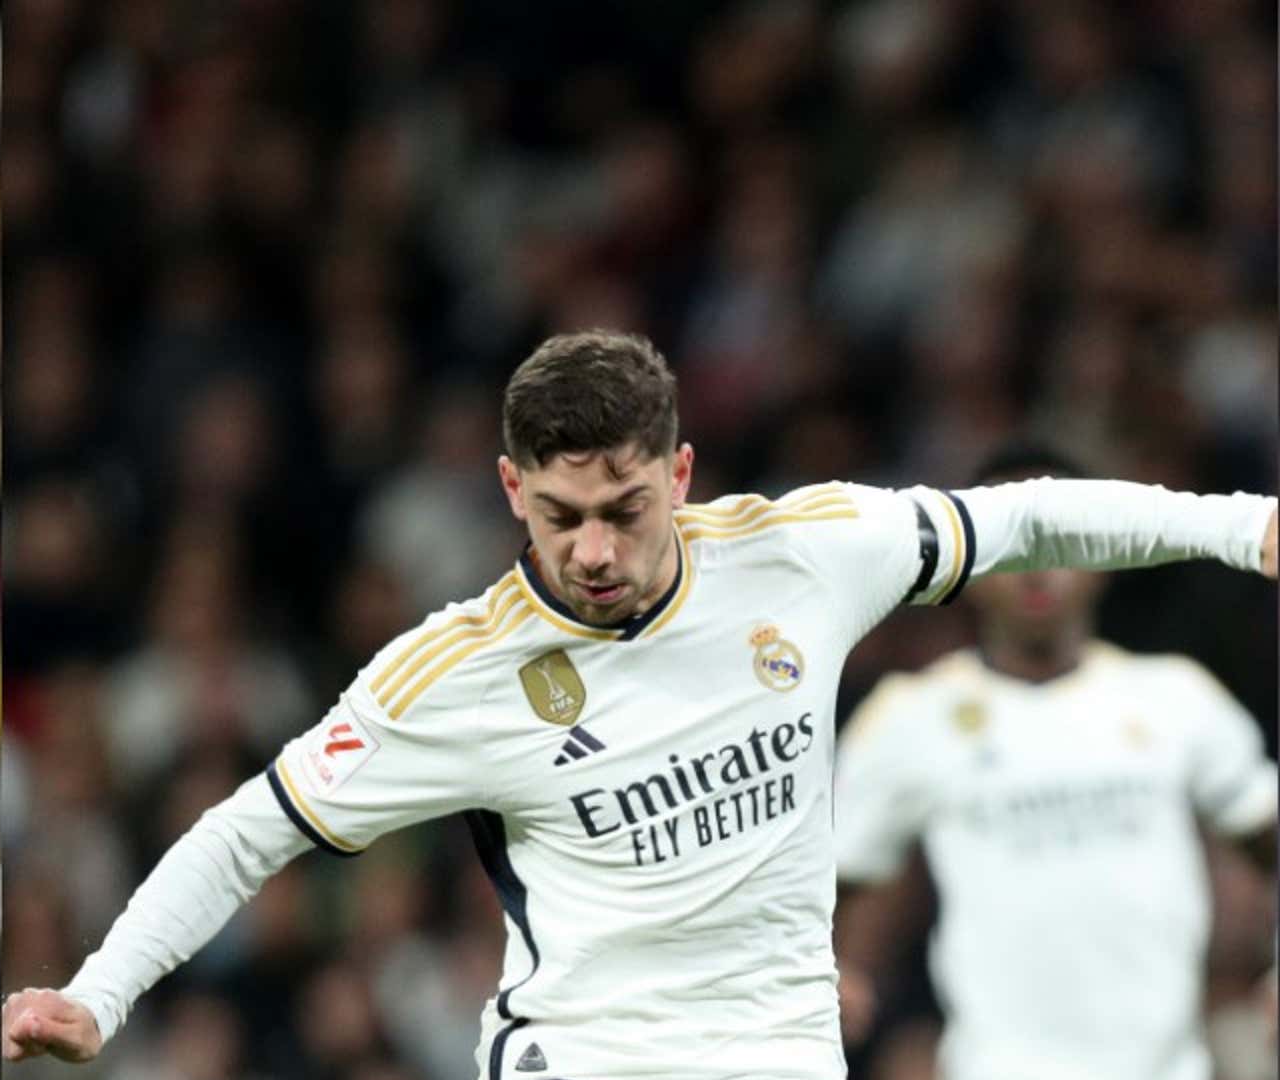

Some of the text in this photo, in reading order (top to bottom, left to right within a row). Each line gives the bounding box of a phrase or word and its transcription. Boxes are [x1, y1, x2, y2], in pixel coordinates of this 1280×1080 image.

[569, 711, 814, 839] Emirates
[631, 773, 796, 866] FLY BETTER
